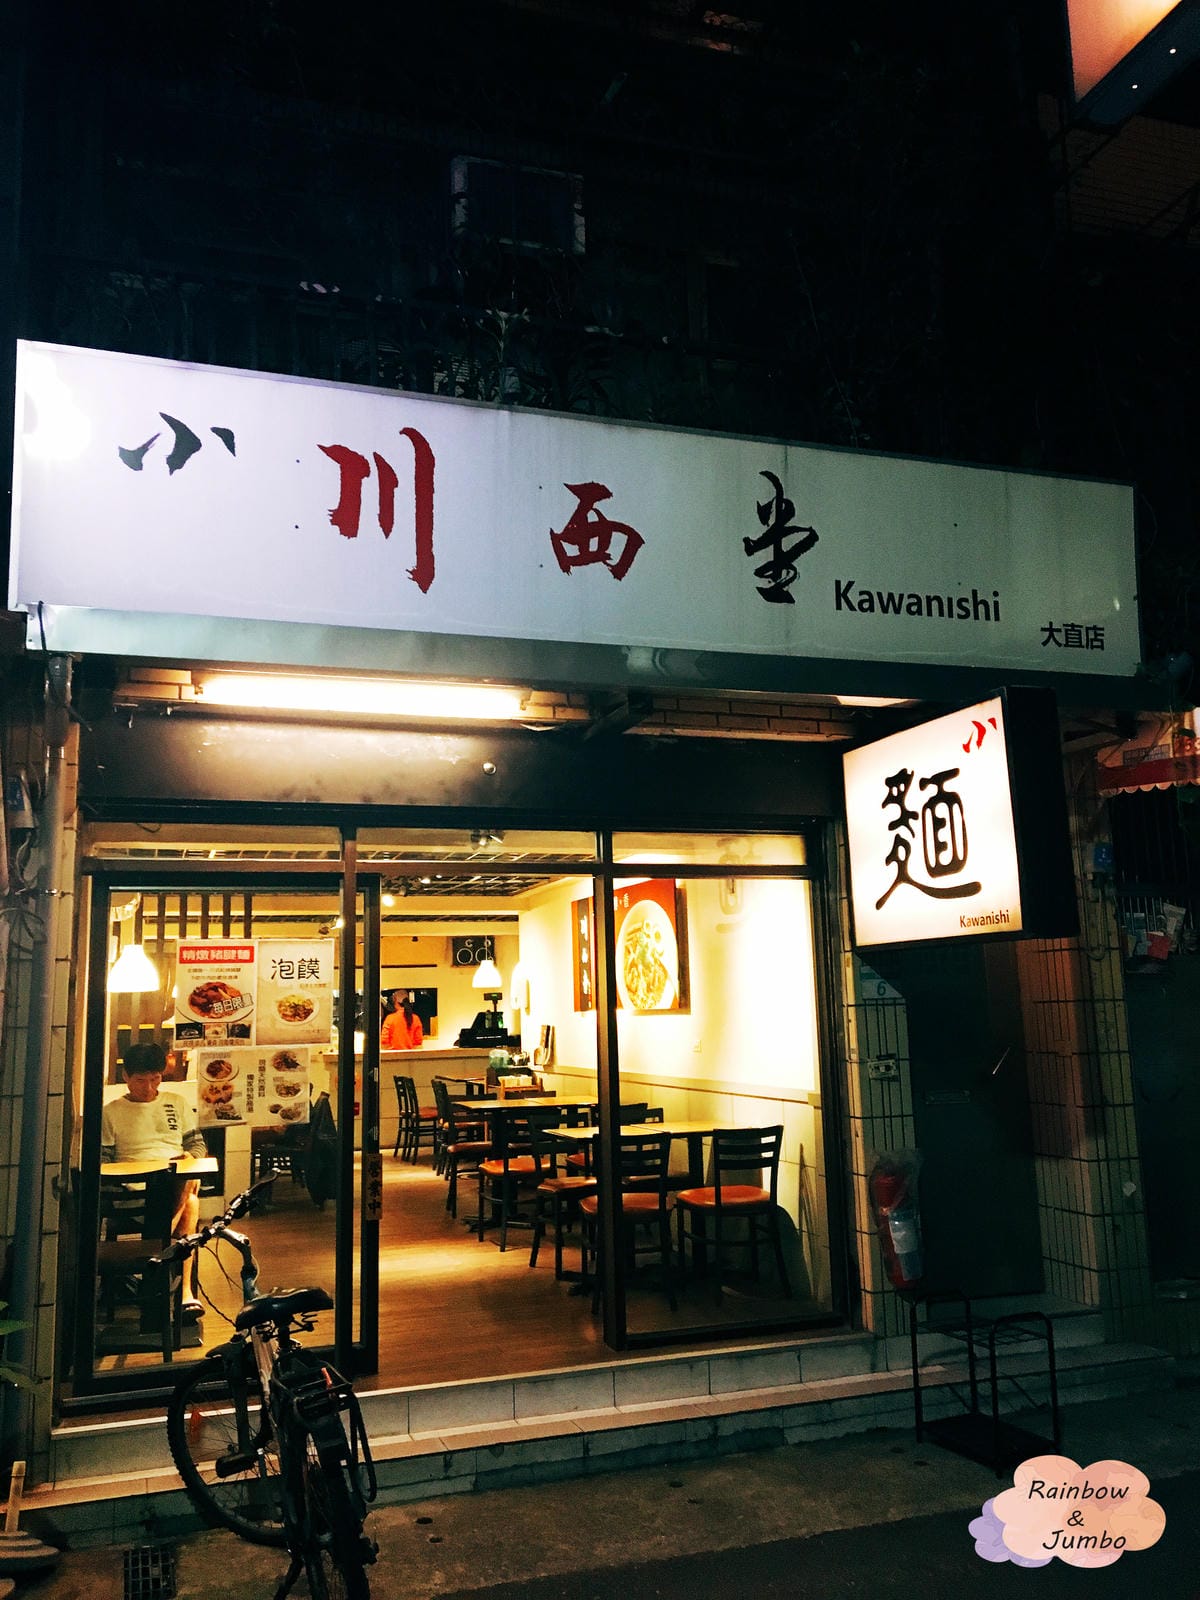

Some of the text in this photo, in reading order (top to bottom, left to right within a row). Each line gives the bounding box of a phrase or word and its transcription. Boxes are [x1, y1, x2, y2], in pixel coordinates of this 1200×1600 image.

[118, 411, 819, 604] 小川西堂
[834, 579, 1001, 621] Kawanishi
[1040, 621, 1105, 651] 大直店
[962, 717, 998, 754] 小
[875, 767, 982, 911] 麵
[959, 909, 1010, 929] Kawanishi
[271, 958, 321, 980] 泡饃
[163, 1103, 178, 1131] FITCH
